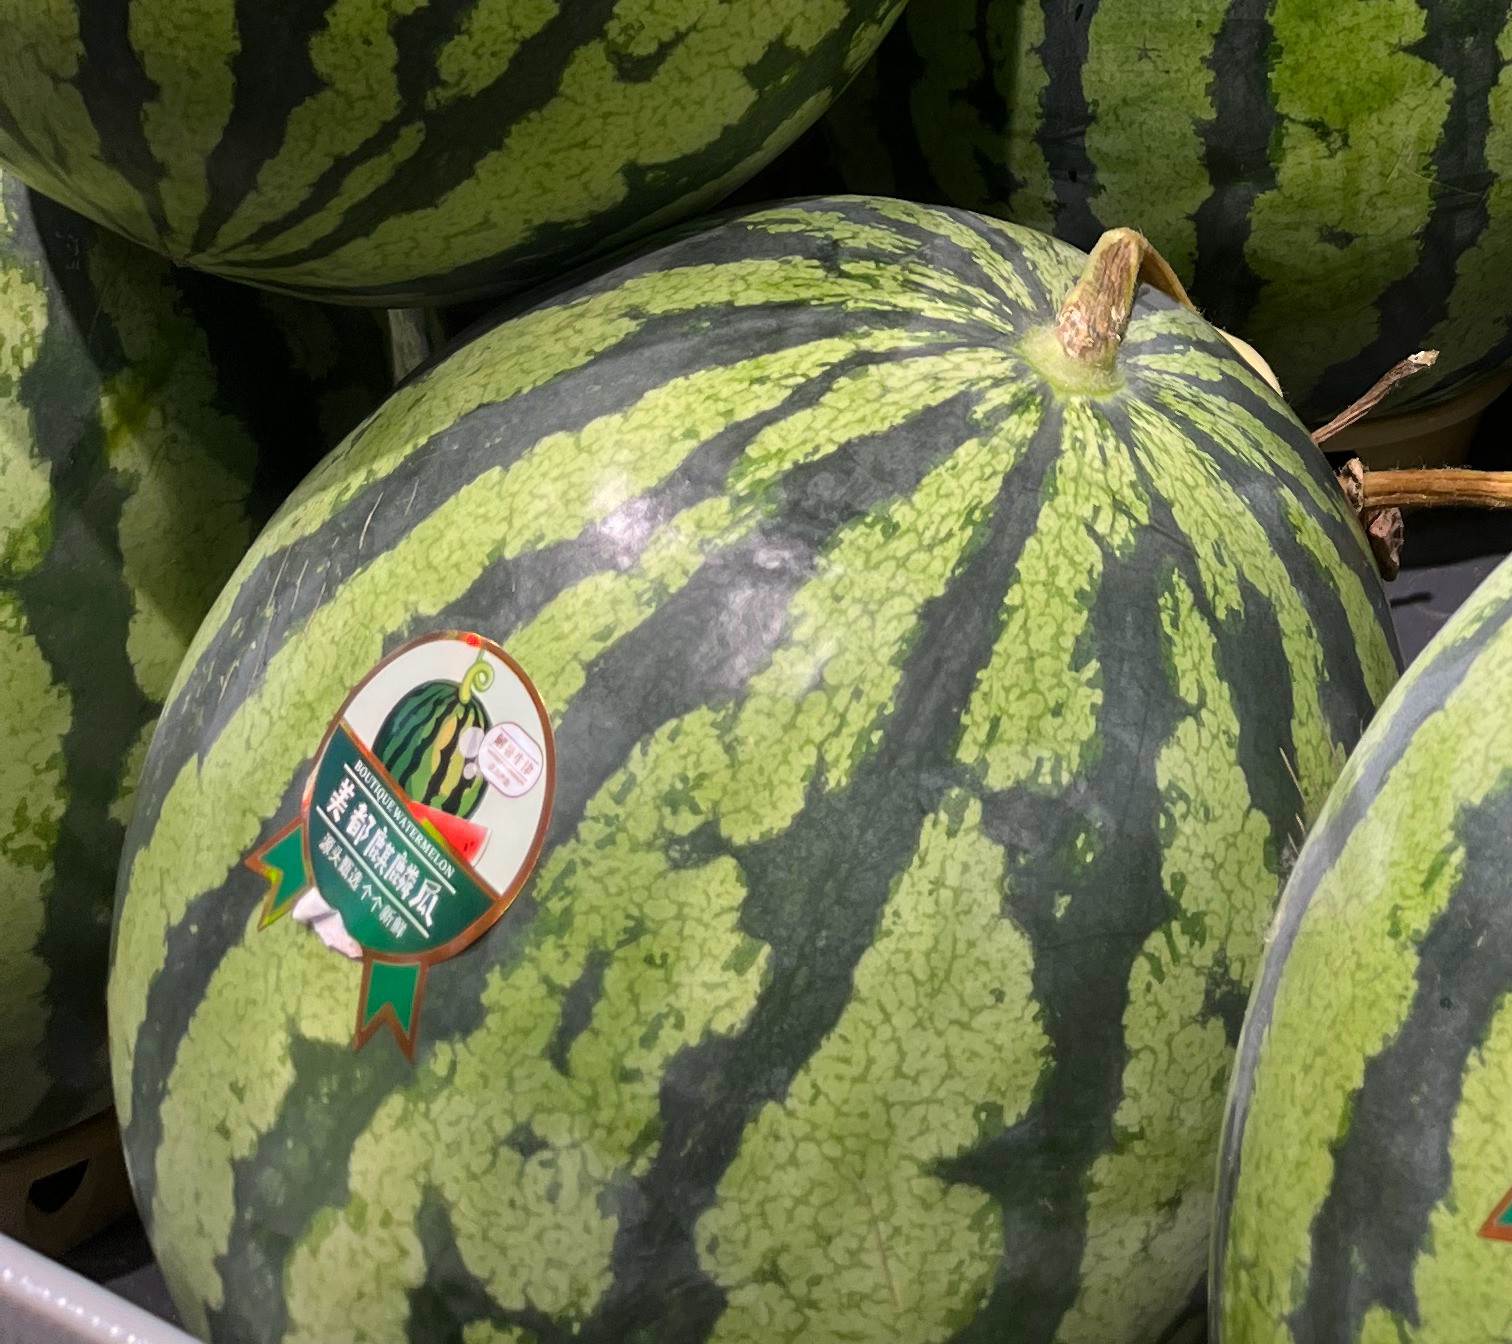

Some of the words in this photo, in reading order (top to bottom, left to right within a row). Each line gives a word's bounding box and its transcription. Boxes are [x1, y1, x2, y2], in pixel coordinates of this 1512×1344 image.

[327, 777, 442, 927] 美都麒麟瓜
[354, 760, 394, 812] BOUTIQUE
[393, 809, 455, 879] WATERMELON
